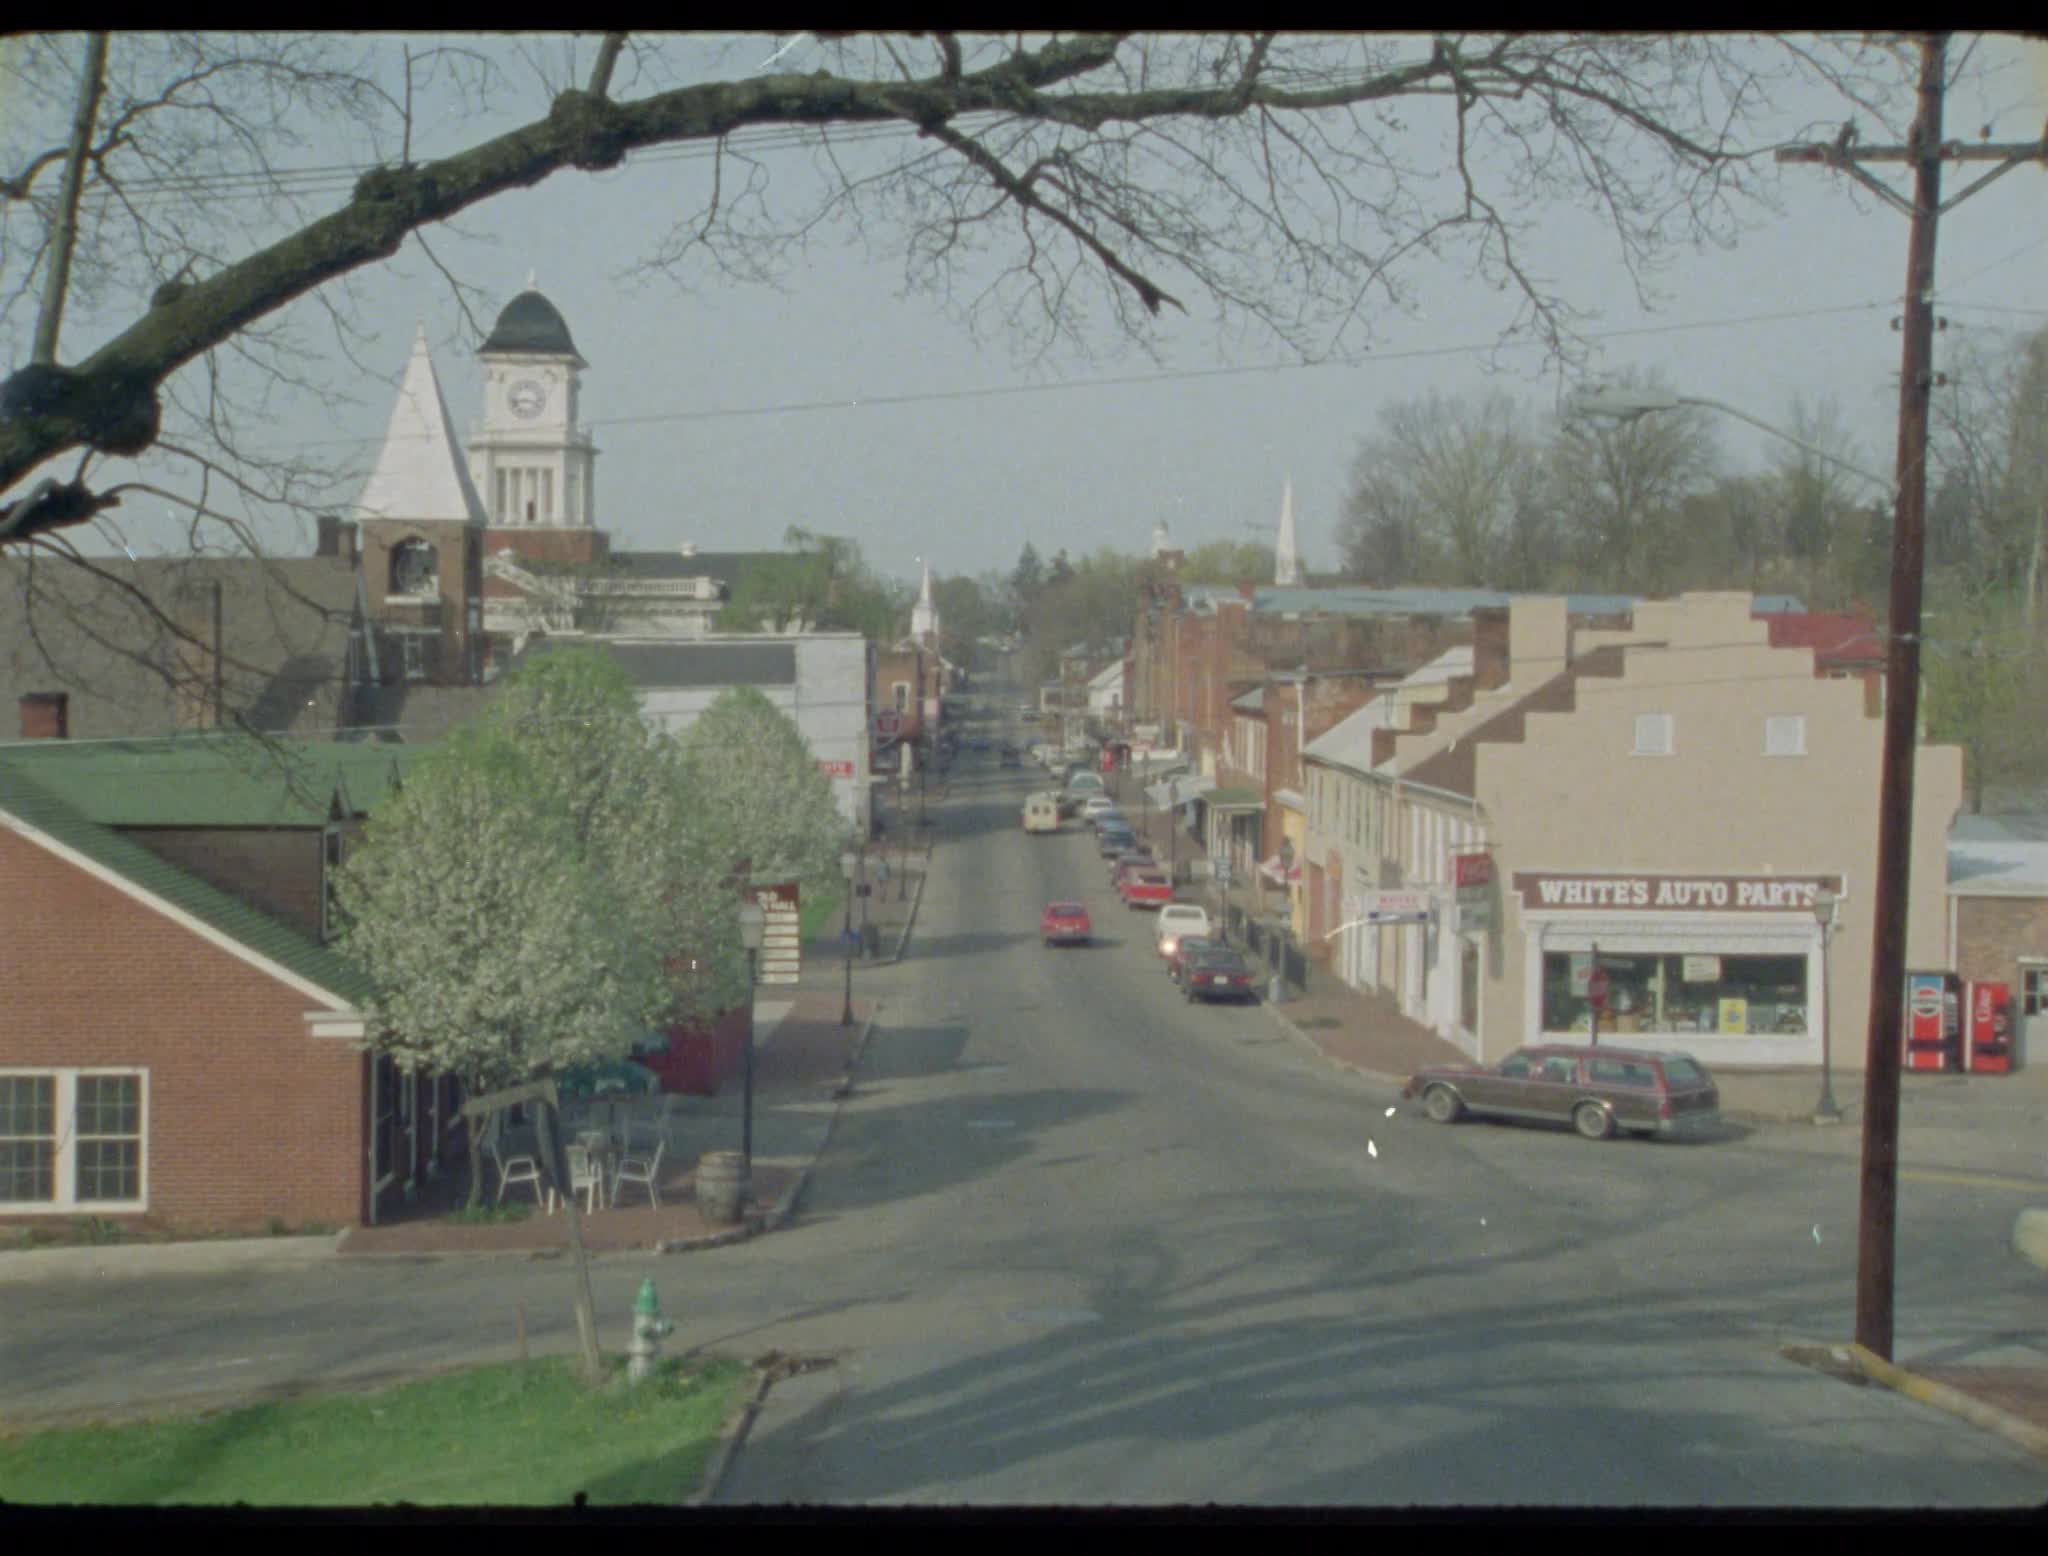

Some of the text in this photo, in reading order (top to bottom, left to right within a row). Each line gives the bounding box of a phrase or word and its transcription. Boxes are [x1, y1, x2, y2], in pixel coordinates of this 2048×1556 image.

[1538, 880, 1820, 907] WHITE'S AUTO PARTS
